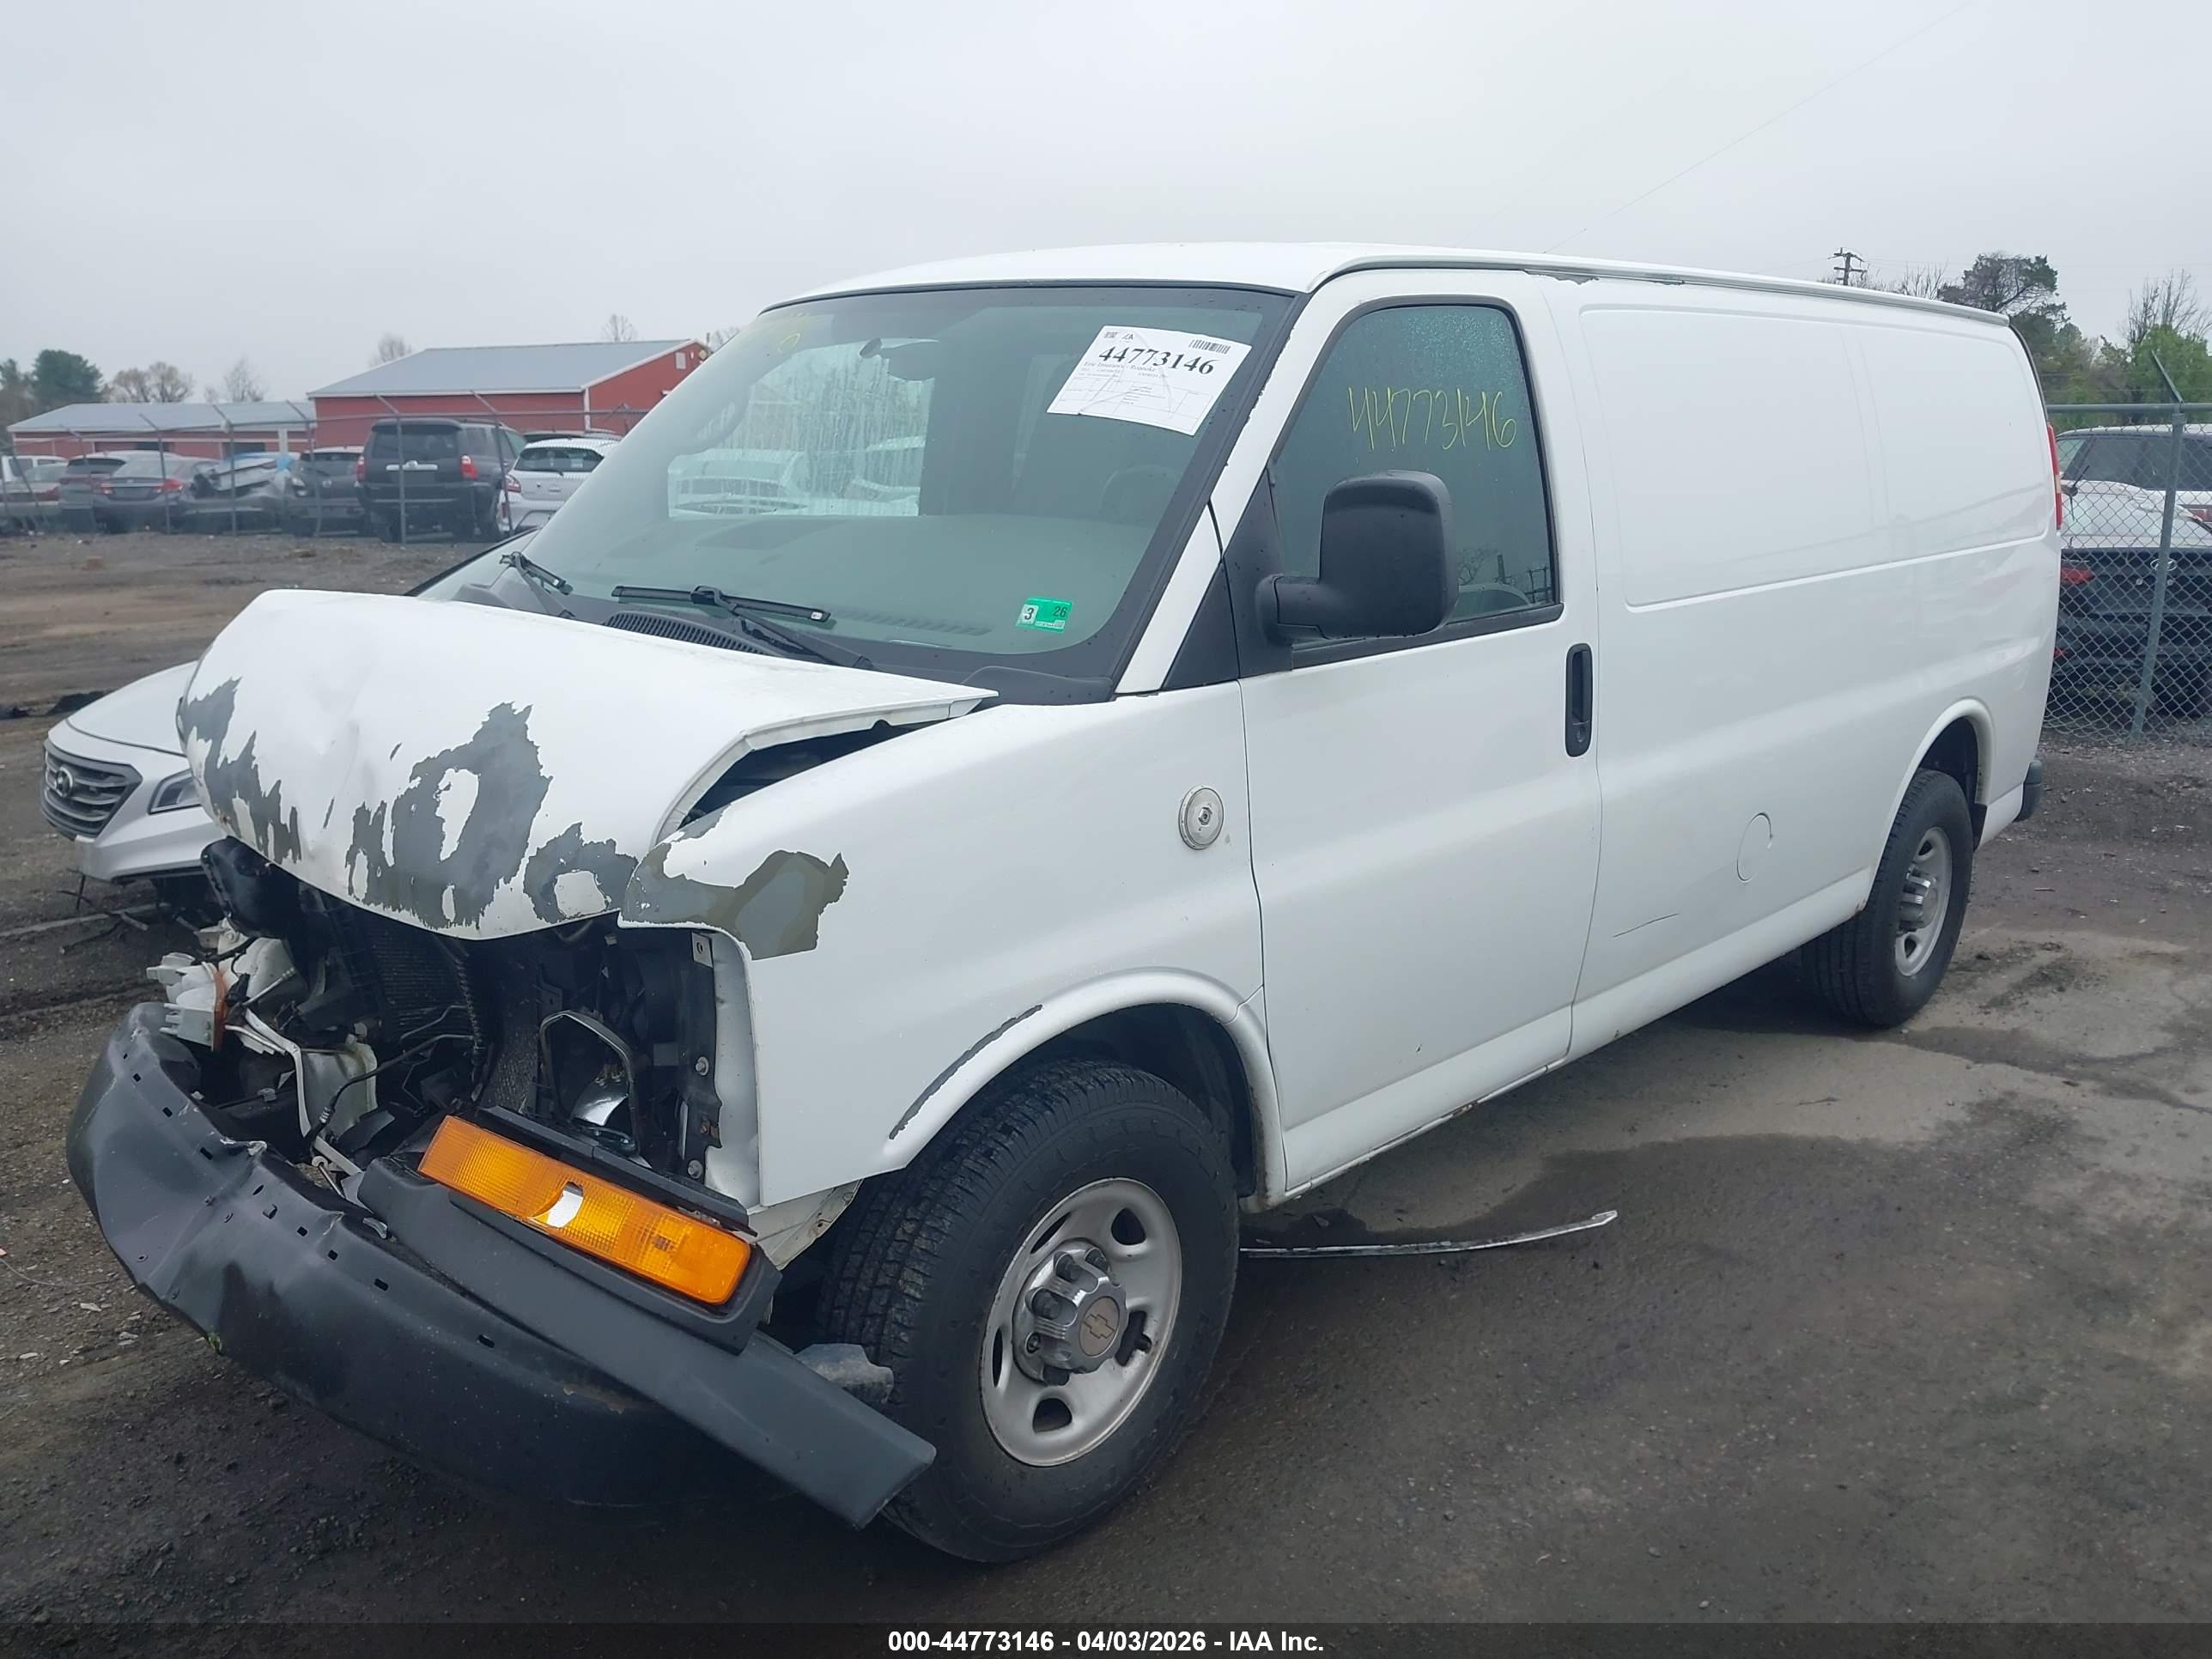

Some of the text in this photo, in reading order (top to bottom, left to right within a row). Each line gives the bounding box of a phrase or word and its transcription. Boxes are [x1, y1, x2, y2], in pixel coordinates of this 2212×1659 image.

[1099, 346, 1221, 374] 44773146
[1348, 386, 1516, 451] 44773146
[1024, 607, 1034, 620] 3
[1053, 605, 1067, 617] 26
